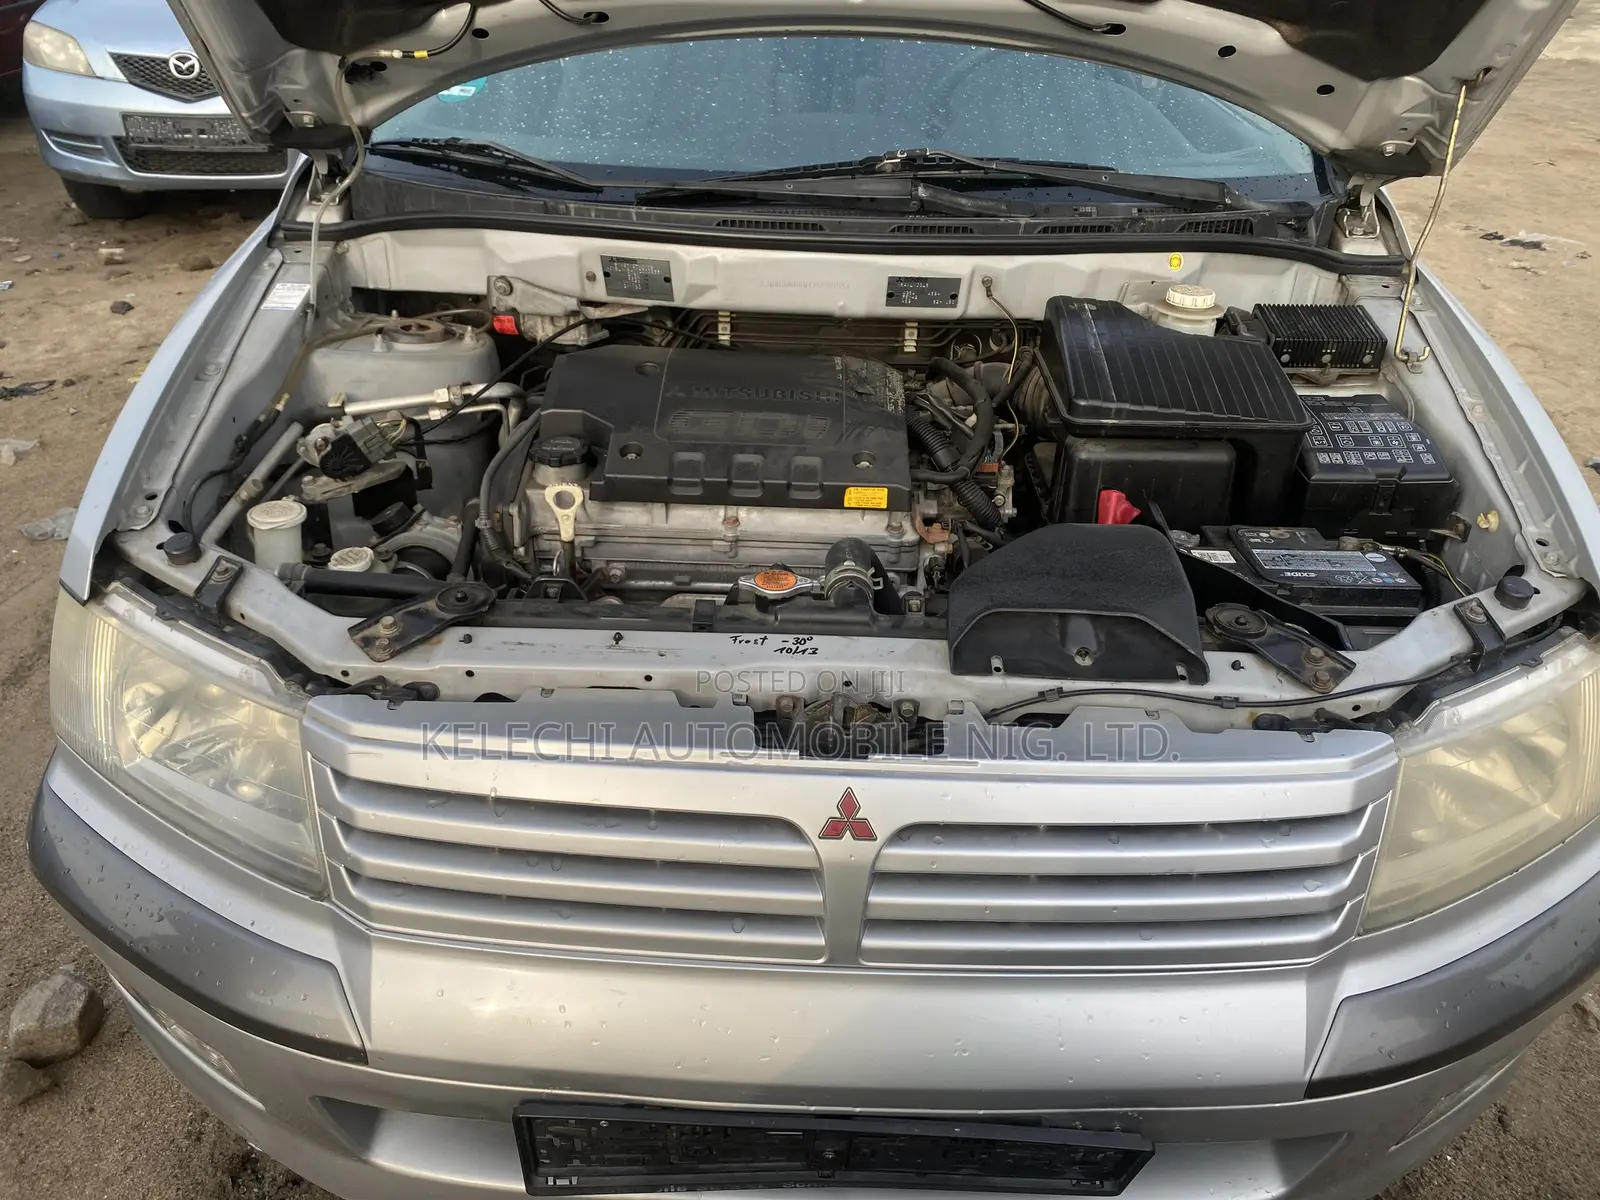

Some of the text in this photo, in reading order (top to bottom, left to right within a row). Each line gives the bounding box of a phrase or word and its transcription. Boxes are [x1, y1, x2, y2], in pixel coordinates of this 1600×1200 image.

[692, 385, 842, 404] MITSUBISHI
[729, 634, 769, 646] Frost
[773, 645, 819, 656] 10/13
